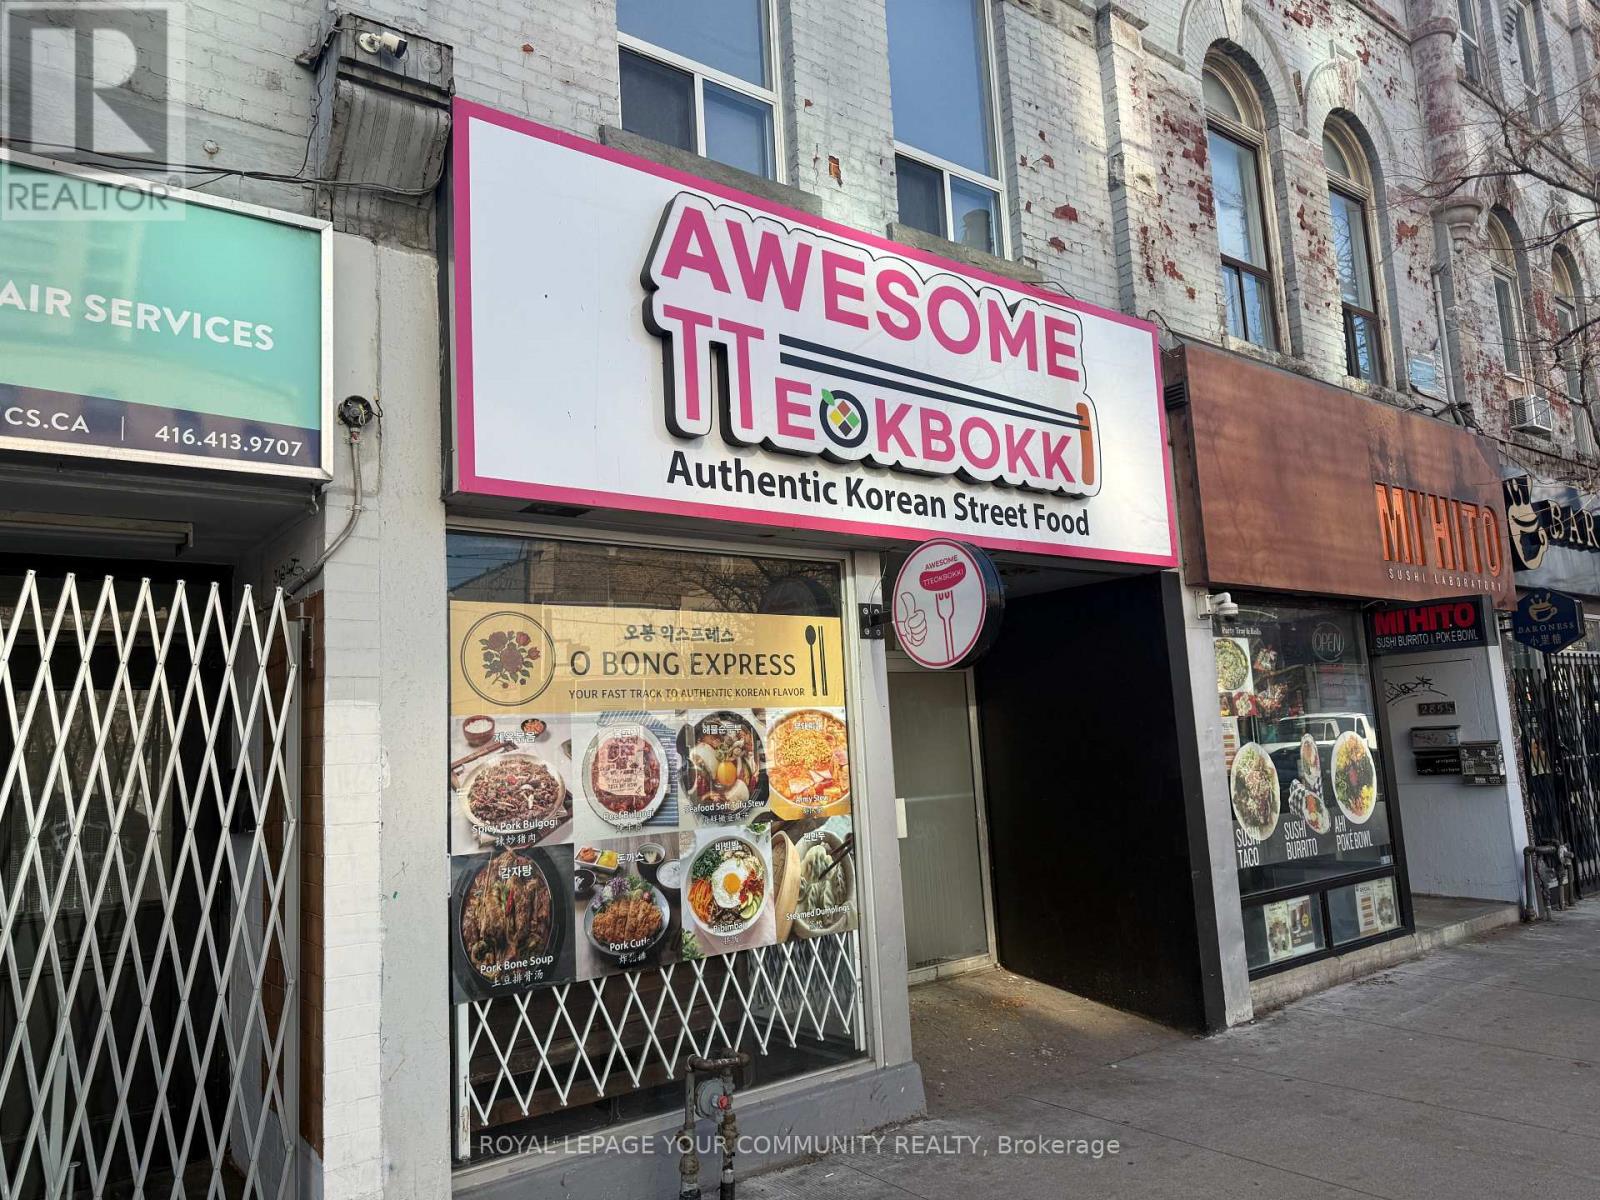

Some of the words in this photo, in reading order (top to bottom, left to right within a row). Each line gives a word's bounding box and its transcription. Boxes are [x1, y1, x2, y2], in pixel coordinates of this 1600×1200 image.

[661, 206, 1079, 383] AWESOME
[0, 279, 71, 318] AIR
[85, 293, 275, 351] SERVICES
[5, 406, 90, 434] CS.CA
[155, 425, 303, 458] 416.413.9707
[667, 450, 837, 504] Authentic
[846, 476, 945, 517] Korean
[953, 498, 1028, 530] Street
[1034, 509, 1090, 537] Food
[1549, 499, 1600, 549] BAR
[924, 555, 958, 571] AWESOME
[1389, 567, 1427, 584] SUSHI
[624, 624, 656, 641] 오봉
[660, 624, 735, 643] 익스프레스
[1517, 622, 1576, 635] BARONESS
[1318, 631, 1341, 652] OPEN
[1376, 635, 1397, 649] SUSHI
[1398, 632, 1429, 648] BURRITO
[570, 650, 591, 676] O
[602, 650, 680, 676] BONG
[690, 652, 796, 676] EXPRESS
[569, 688, 598, 699] YOUR
[602, 688, 627, 699] FAST
[630, 688, 662, 698] TRACK
[666, 688, 678, 698] TO
[681, 687, 733, 698] AUTHENTIC
[735, 687, 770, 697] KOREAN
[773, 687, 805, 697] FLAVOR
[684, 803, 714, 814] eafood
[716, 800, 730, 811] Soft
[747, 799, 765, 808] Stew
[471, 824, 498, 836] Spicy
[500, 820, 521, 831] Pork
[523, 819, 558, 830] Bulgogi
[1284, 819, 1307, 841] SUSHI
[1335, 816, 1347, 834] AHI
[1236, 827, 1261, 848] SUSHI
[1238, 847, 1260, 869] TACO
[1286, 838, 1318, 860] BURRITO
[501, 865, 533, 879] 감자탕
[786, 909, 815, 920] Steamed
[816, 904, 850, 917] Dumplings
[609, 940, 629, 951] Pork
[630, 936, 653, 948] Cutle
[480, 962, 502, 974] Pork
[504, 959, 528, 971] Bone
[529, 955, 554, 968] Soup
